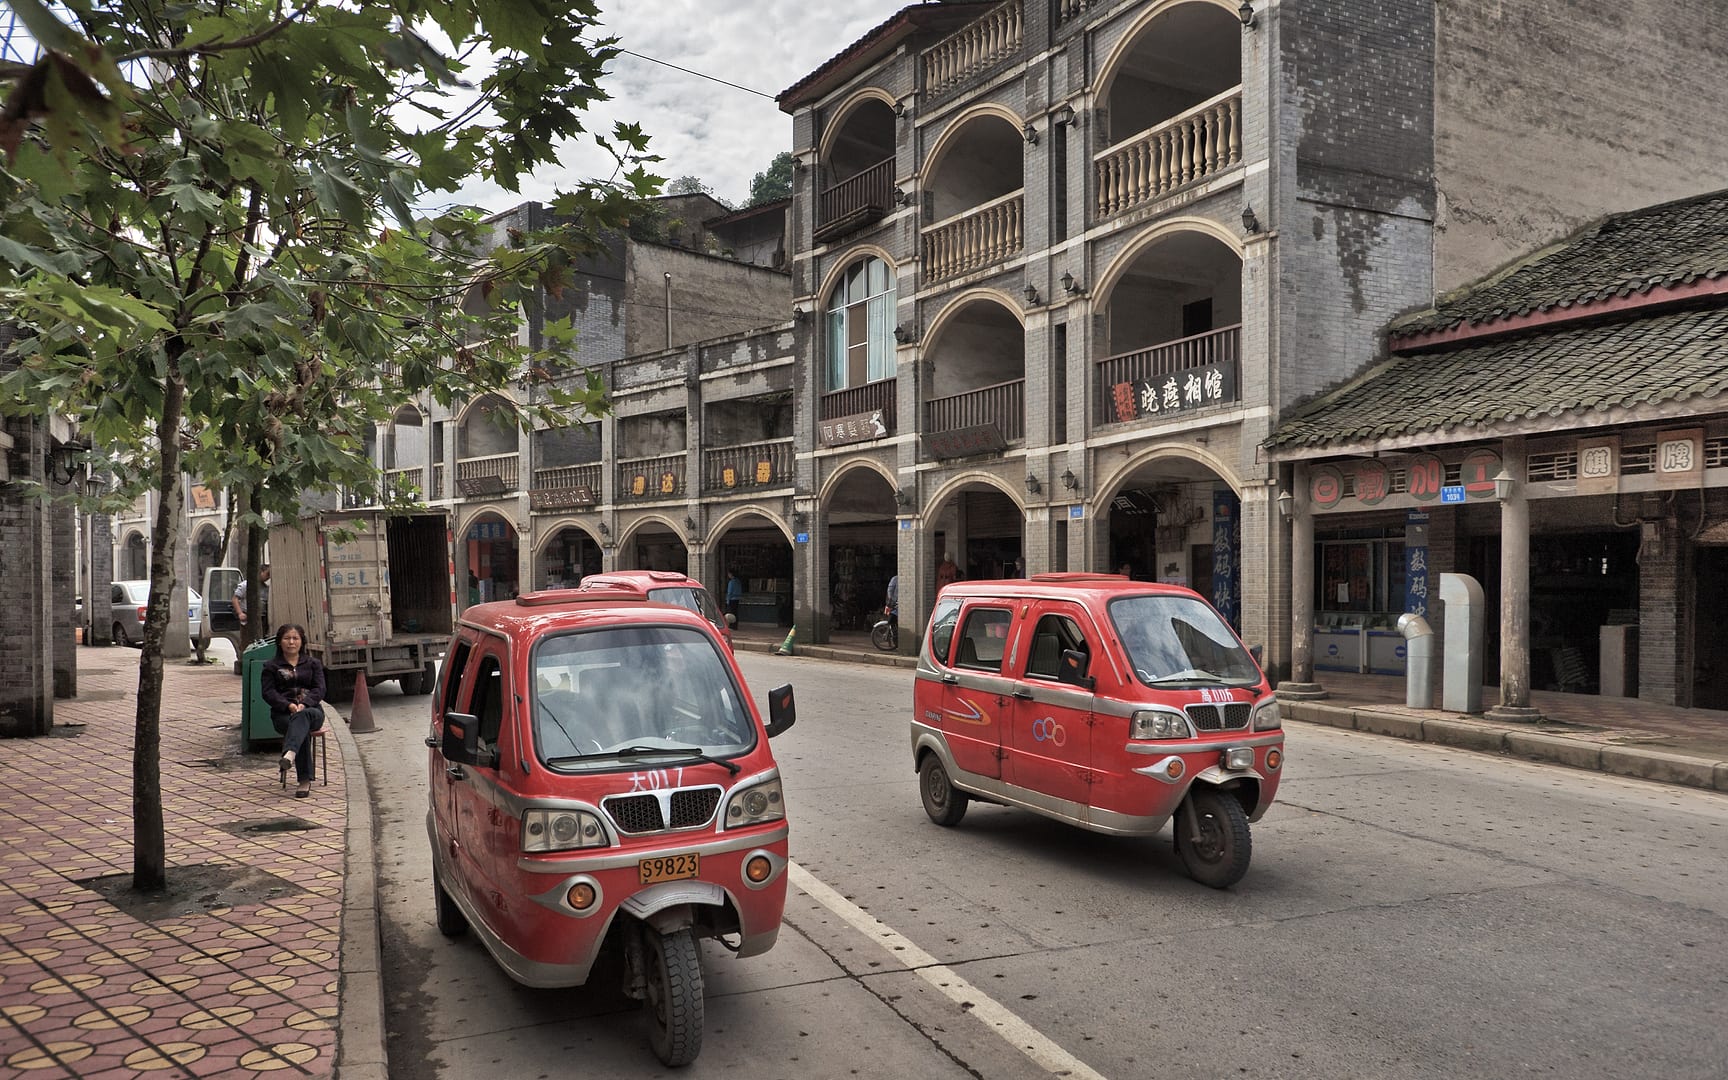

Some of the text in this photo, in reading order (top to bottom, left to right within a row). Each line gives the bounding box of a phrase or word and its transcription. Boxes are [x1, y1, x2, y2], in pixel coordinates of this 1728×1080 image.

[1585, 442, 1691, 474] 棋牌
[1214, 527, 1231, 620] 数码快
[643, 855, 697, 878] S9823
